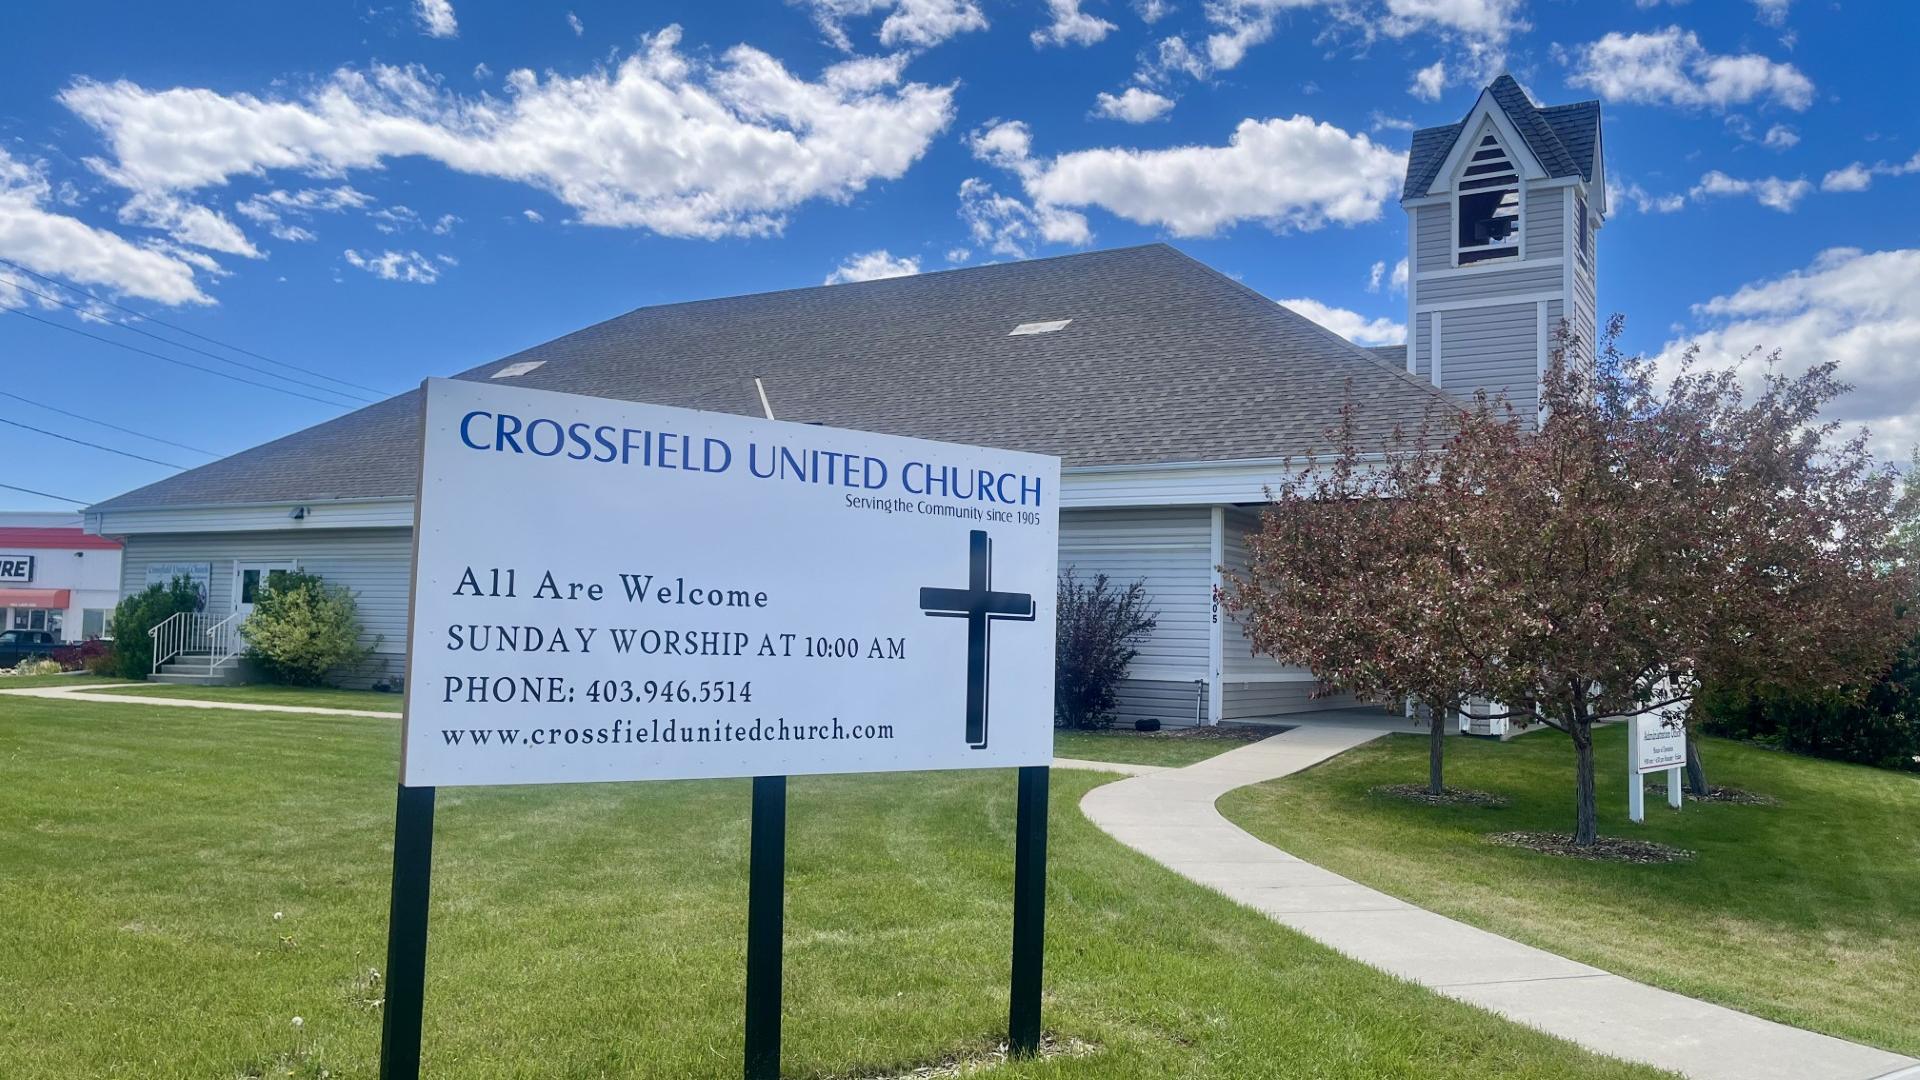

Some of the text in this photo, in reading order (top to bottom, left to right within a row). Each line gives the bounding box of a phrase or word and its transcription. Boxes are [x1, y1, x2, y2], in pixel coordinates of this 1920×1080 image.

[460, 410, 1042, 507] CROSSFIELD UNITED CHURCH
[845, 494, 1041, 526] Serving the Community since 1905
[452, 566, 769, 608] All Are Welcome
[446, 624, 907, 660] SUNDAY WORSHIP AT 10:00 AM
[443, 676, 753, 704] PHONE: 403.946.5514
[441, 717, 895, 748] www.crossfieldunitedchurch.com
